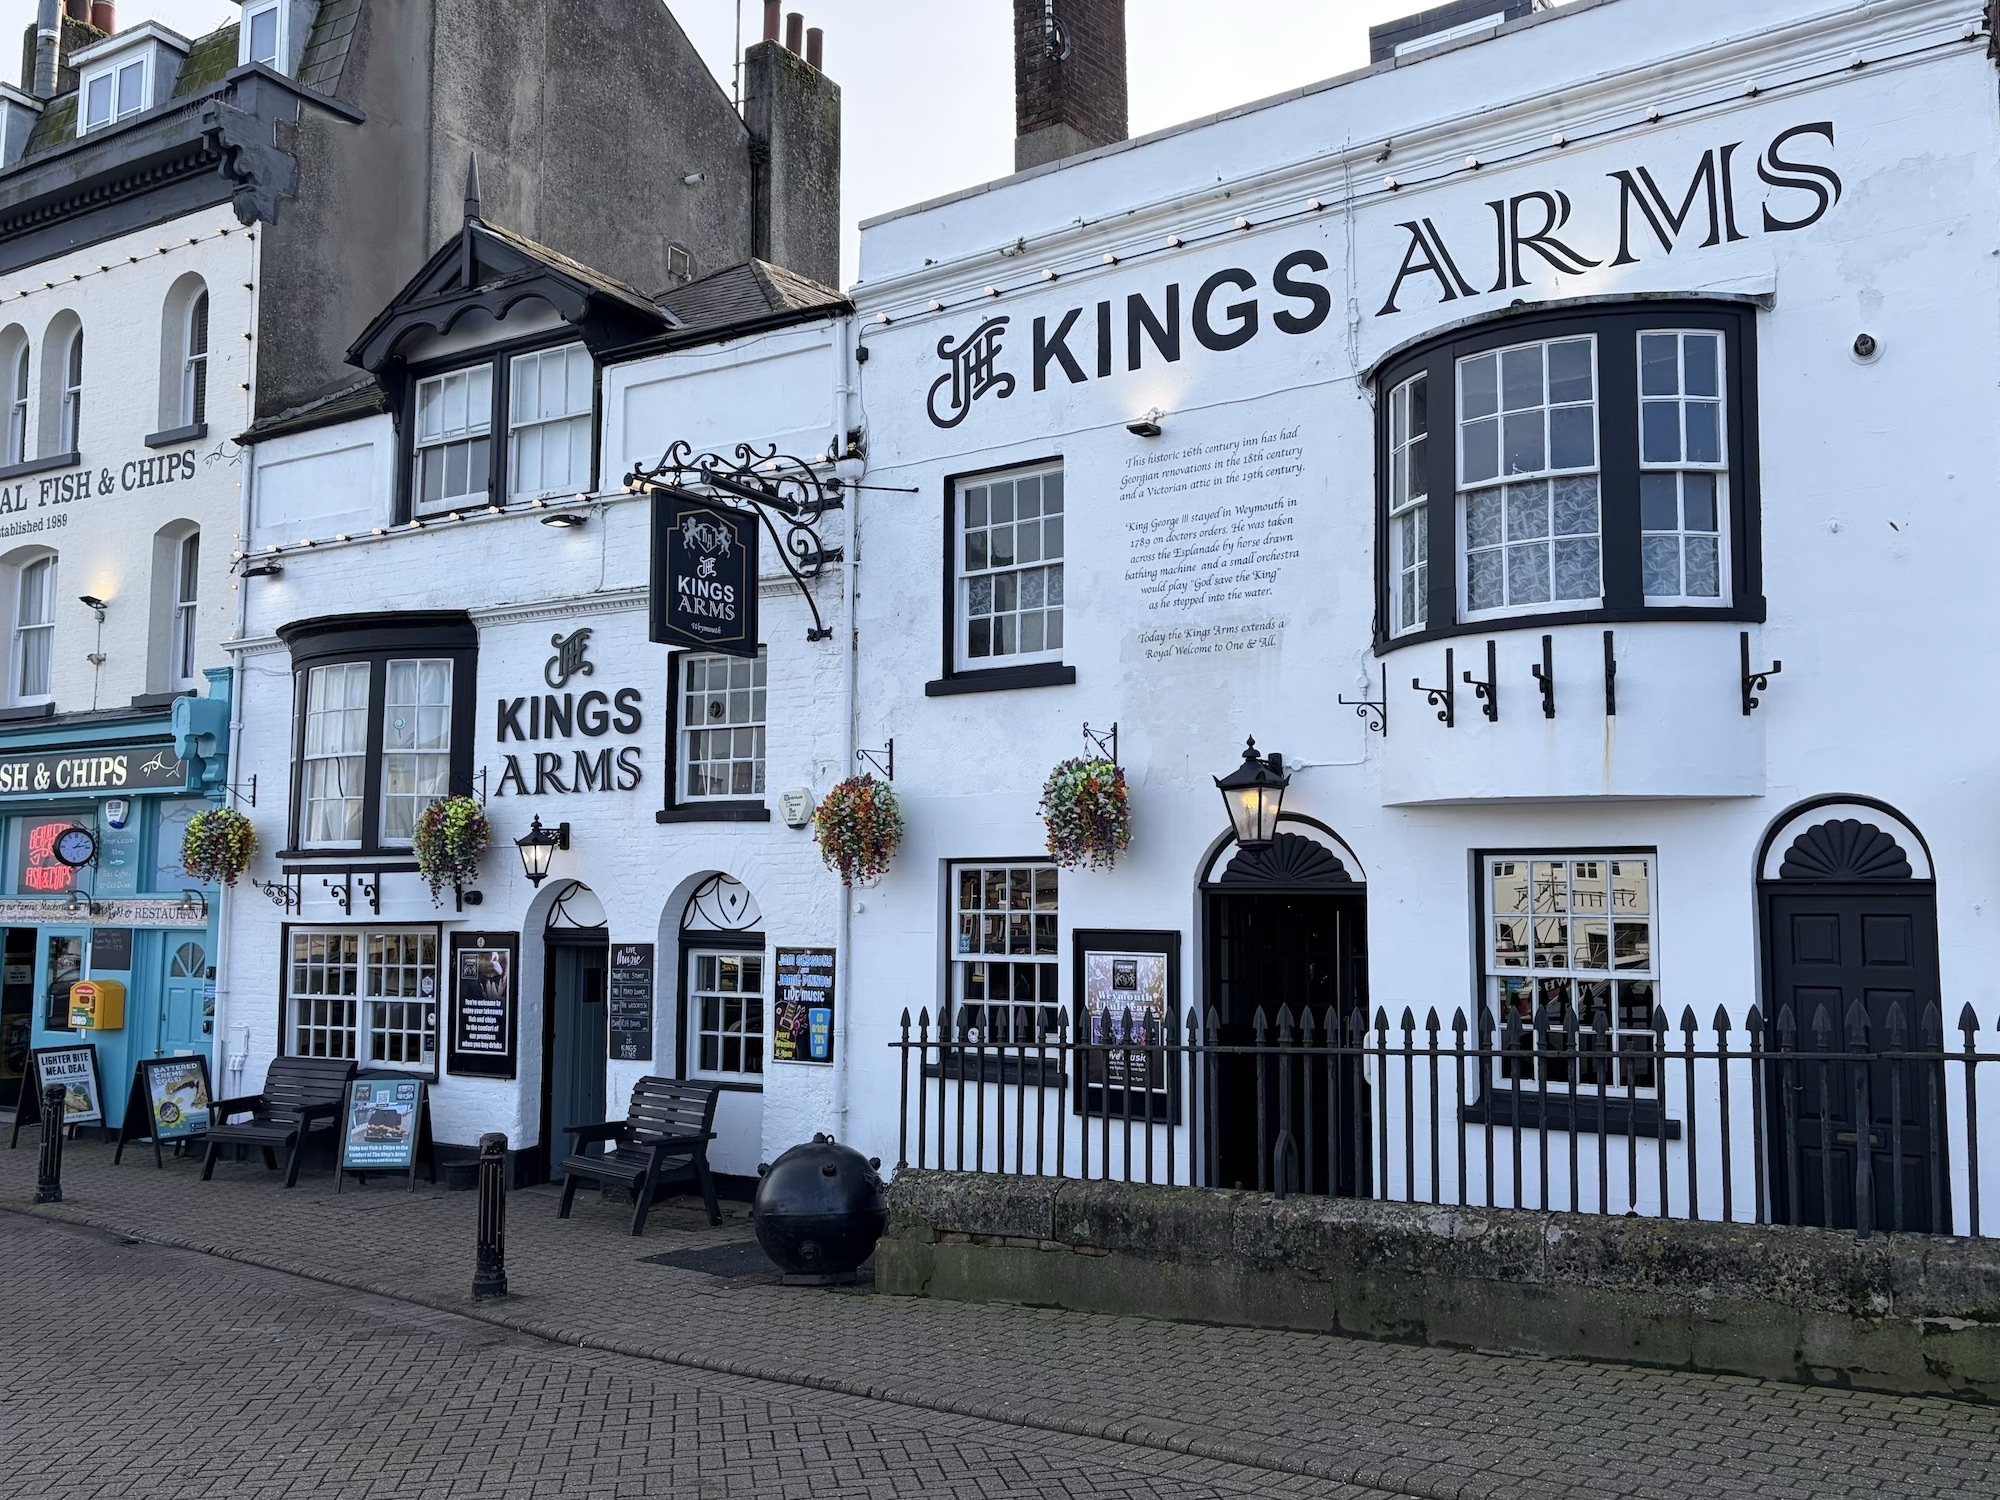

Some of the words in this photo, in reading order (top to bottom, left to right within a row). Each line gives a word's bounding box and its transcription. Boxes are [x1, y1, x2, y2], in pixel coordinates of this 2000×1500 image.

[1032, 248, 1332, 391] KINGS
[1375, 121, 1843, 318] ARMS
[1126, 455, 1146, 468] This
[1148, 451, 1180, 464] historic
[1182, 443, 1202, 458] 16th
[1205, 440, 1240, 455] century
[1243, 437, 1258, 446] inn
[1261, 431, 1277, 444] has
[1279, 425, 1301, 441] had
[38, 471, 92, 507] FISH
[98, 468, 114, 495] &
[121, 449, 196, 491] CHIPS
[1120, 472, 1159, 490] Georgian
[1162, 463, 1212, 478] renovations
[1215, 459, 1224, 469] in
[1227, 456, 1240, 467] the
[1243, 449, 1264, 464] 18th
[1266, 446, 1303, 461] century
[1120, 488, 1137, 501] and
[1147, 483, 1187, 496] Victorian
[1190, 479, 1211, 489] attic
[1213, 476, 1223, 486] in
[1226, 471, 1240, 483] the
[1242, 466, 1264, 482] 19th
[1266, 463, 1306, 477] century.
[46, 513, 68, 530] 1989
[1126, 519, 1149, 534] King
[1151, 516, 1180, 532] George
[1191, 507, 1220, 525] stayed
[1222, 507, 1232, 517] in
[1235, 497, 1284, 518] Weymouth
[1287, 498, 1297, 507] in
[1130, 538, 1151, 549] 1789
[1153, 536, 1164, 544] on
[1166, 530, 1197, 542] doctors
[1200, 525, 1228, 538] orders.
[1231, 519, 1245, 532] He
[1248, 522, 1265, 530] was
[1267, 515, 1293, 527] taken
[1130, 555, 1156, 564] across
[1157, 549, 1171, 561] the
[1173, 542, 1220, 561] Esplanade
[1223, 538, 1234, 554] by
[1237, 536, 1261, 549] horse
[1263, 532, 1293, 545] drawn
[1125, 567, 1157, 582] bathing
[1160, 560, 1196, 576] machine
[1201, 556, 1219, 571] and
[1221, 560, 1227, 568] a
[1230, 551, 1256, 567] small
[1257, 549, 1300, 563] orchestra
[678, 574, 735, 603] KINGS
[1141, 584, 1166, 594] would
[1168, 580, 1188, 596] play
[1215, 575, 1233, 584] save
[1236, 570, 1251, 583] the
[677, 594, 735, 621] ARMS
[1149, 600, 1159, 610] as
[1161, 596, 1170, 608] he
[1173, 591, 1205, 610] stepped
[1208, 591, 1225, 602] into
[1228, 587, 1242, 599] the
[1245, 588, 1273, 598] water.
[691, 622, 722, 634] Weymouth
[1138, 629, 1166, 645] Today
[1168, 628, 1181, 640] the
[1184, 625, 1211, 642] Kings
[1214, 623, 1239, 635] Arms
[1241, 616, 1275, 632] extends
[1145, 644, 1172, 662] Royal
[1175, 640, 1212, 655] Welcome
[1215, 642, 1223, 651] to
[1226, 638, 1244, 650] One
[1247, 636, 1257, 649] &
[1260, 634, 1277, 647] All.
[497, 688, 642, 742] KINGS
[0, 763, 29, 792] SH
[34, 762, 50, 790] &
[56, 755, 128, 789] CHIPS
[494, 746, 642, 797] ARMS
[625, 946, 637, 955] LIVE
[778, 954, 795, 966] JAM
[796, 955, 833, 967] SESSIONS
[777, 974, 801, 986] JAMIE
[784, 989, 800, 1001] LIVE
[801, 990, 825, 1002] MUSIC
[1098, 991, 1153, 1003] Weymouth
[41, 1055, 71, 1066] LIGHTER
[73, 1053, 89, 1063] BITE
[46, 1066, 66, 1076] MEAL
[68, 1063, 87, 1074] DEAL
[153, 1063, 198, 1073] BATTERED
[155, 1070, 184, 1079] CREME
